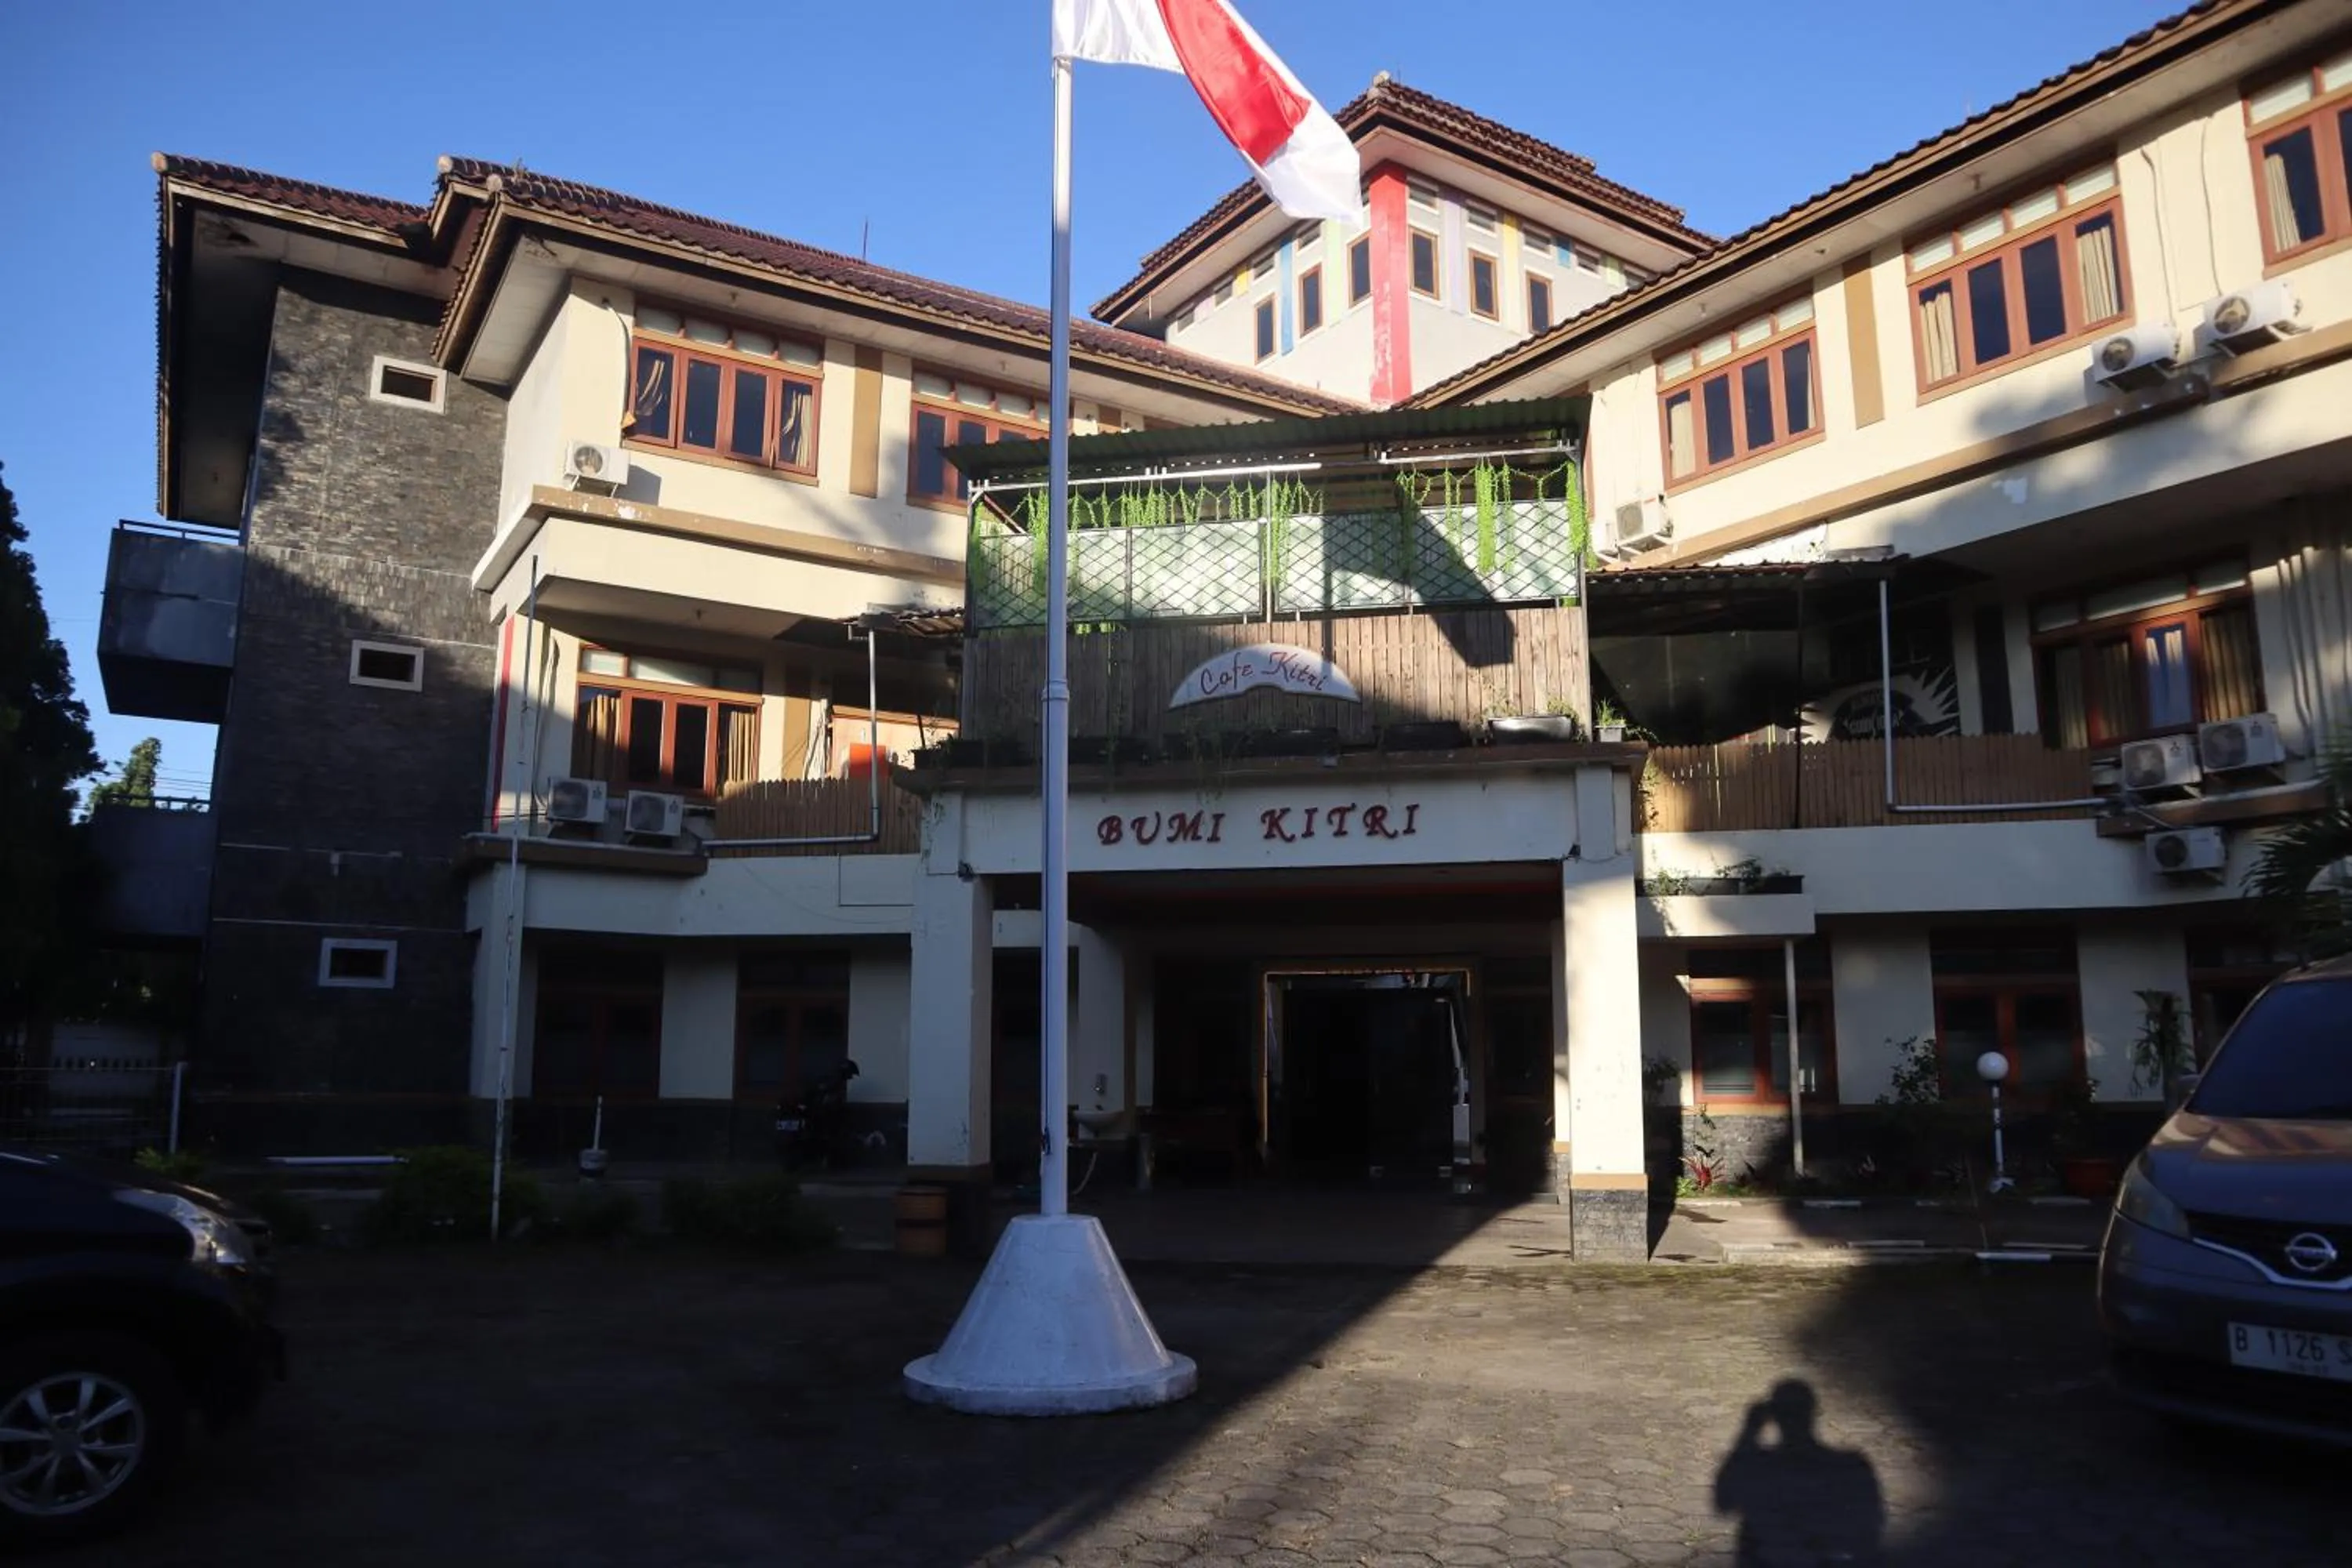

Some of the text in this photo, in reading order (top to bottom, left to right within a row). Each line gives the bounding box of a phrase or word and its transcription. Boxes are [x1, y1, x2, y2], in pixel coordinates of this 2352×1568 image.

[1200, 651, 1327, 695] Cafe Kitri
[1098, 802, 1420, 845] BUMI KITRI
[2234, 1326, 2248, 1352] B
[2267, 1330, 2325, 1362] 1126
